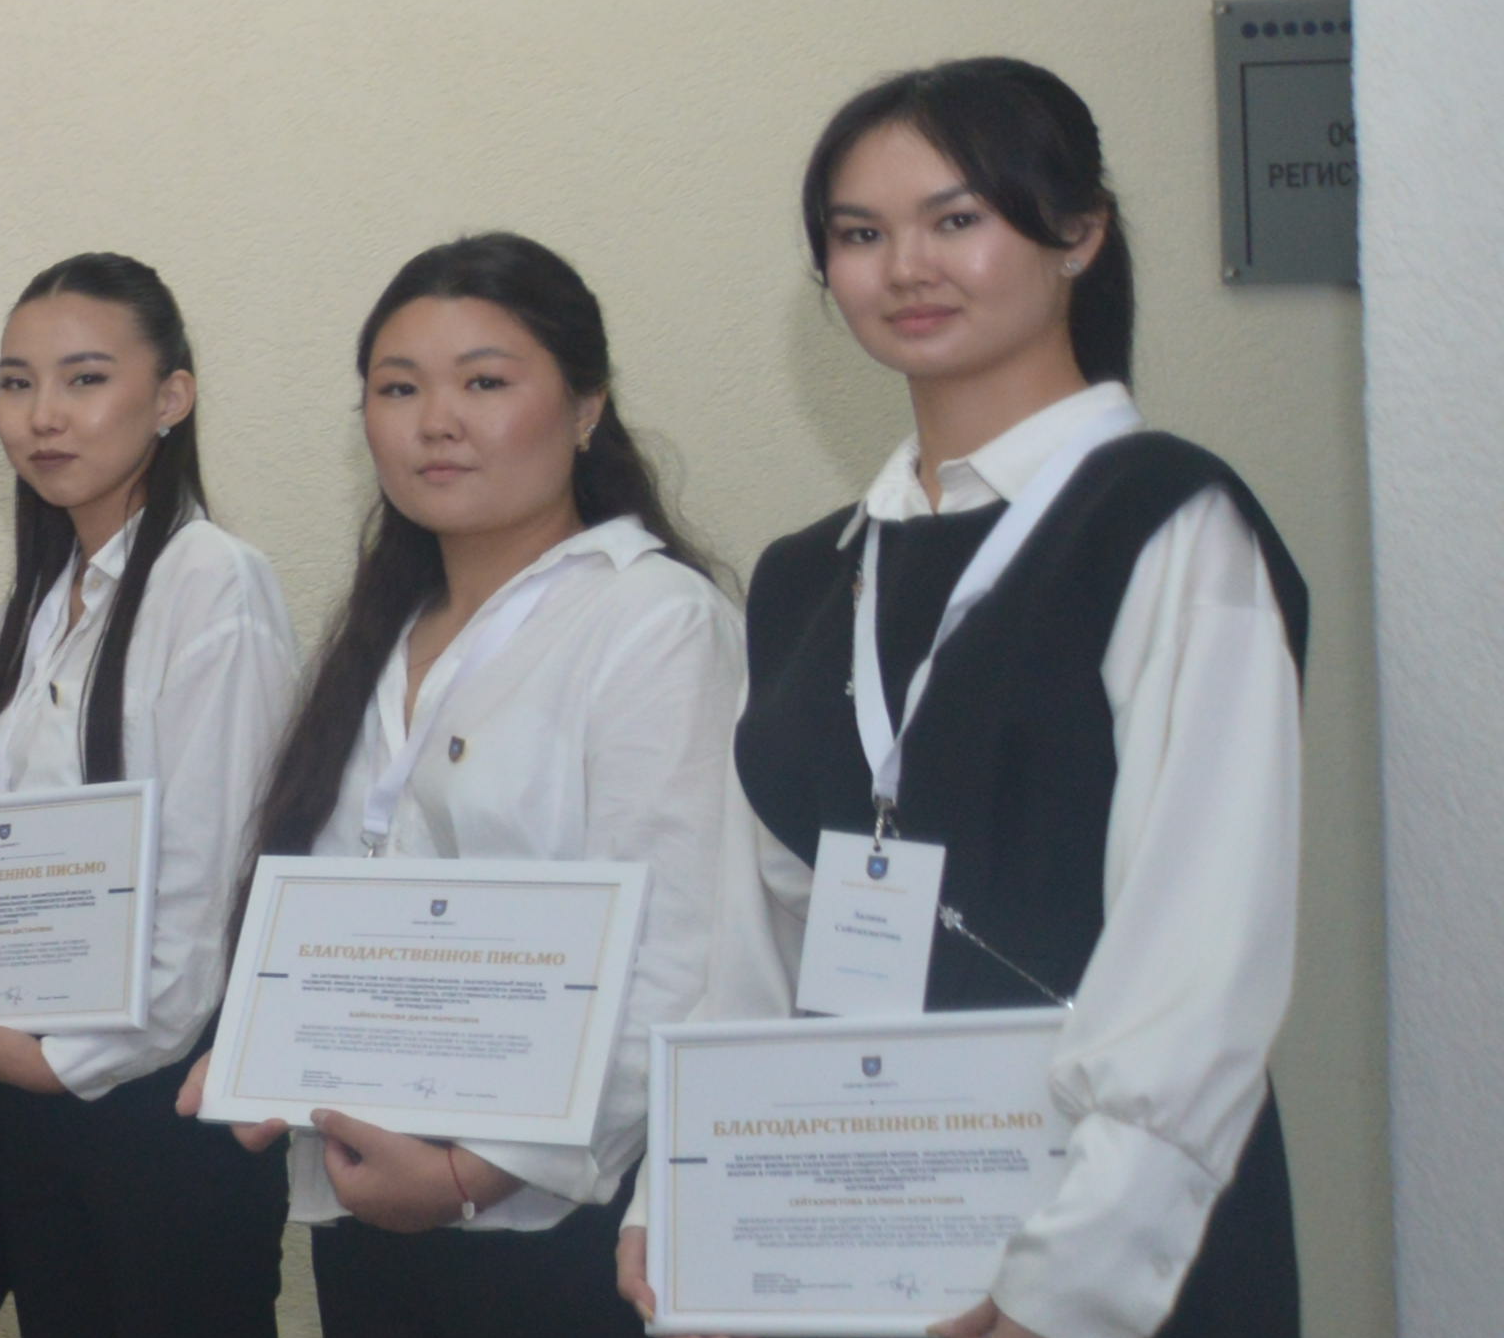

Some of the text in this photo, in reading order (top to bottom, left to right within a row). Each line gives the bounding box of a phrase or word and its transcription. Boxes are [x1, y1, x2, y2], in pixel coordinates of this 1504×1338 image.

[1268, 161, 1358, 188] РЕГИС
[46, 861, 107, 878] ПИСЬМО
[298, 943, 566, 967] БЛАГОДАРСТВЕННОЕ ПИСЬМО
[712, 1111, 1044, 1138] БЛАГОДАРСТВЕННОЕ ПИСЬМО
